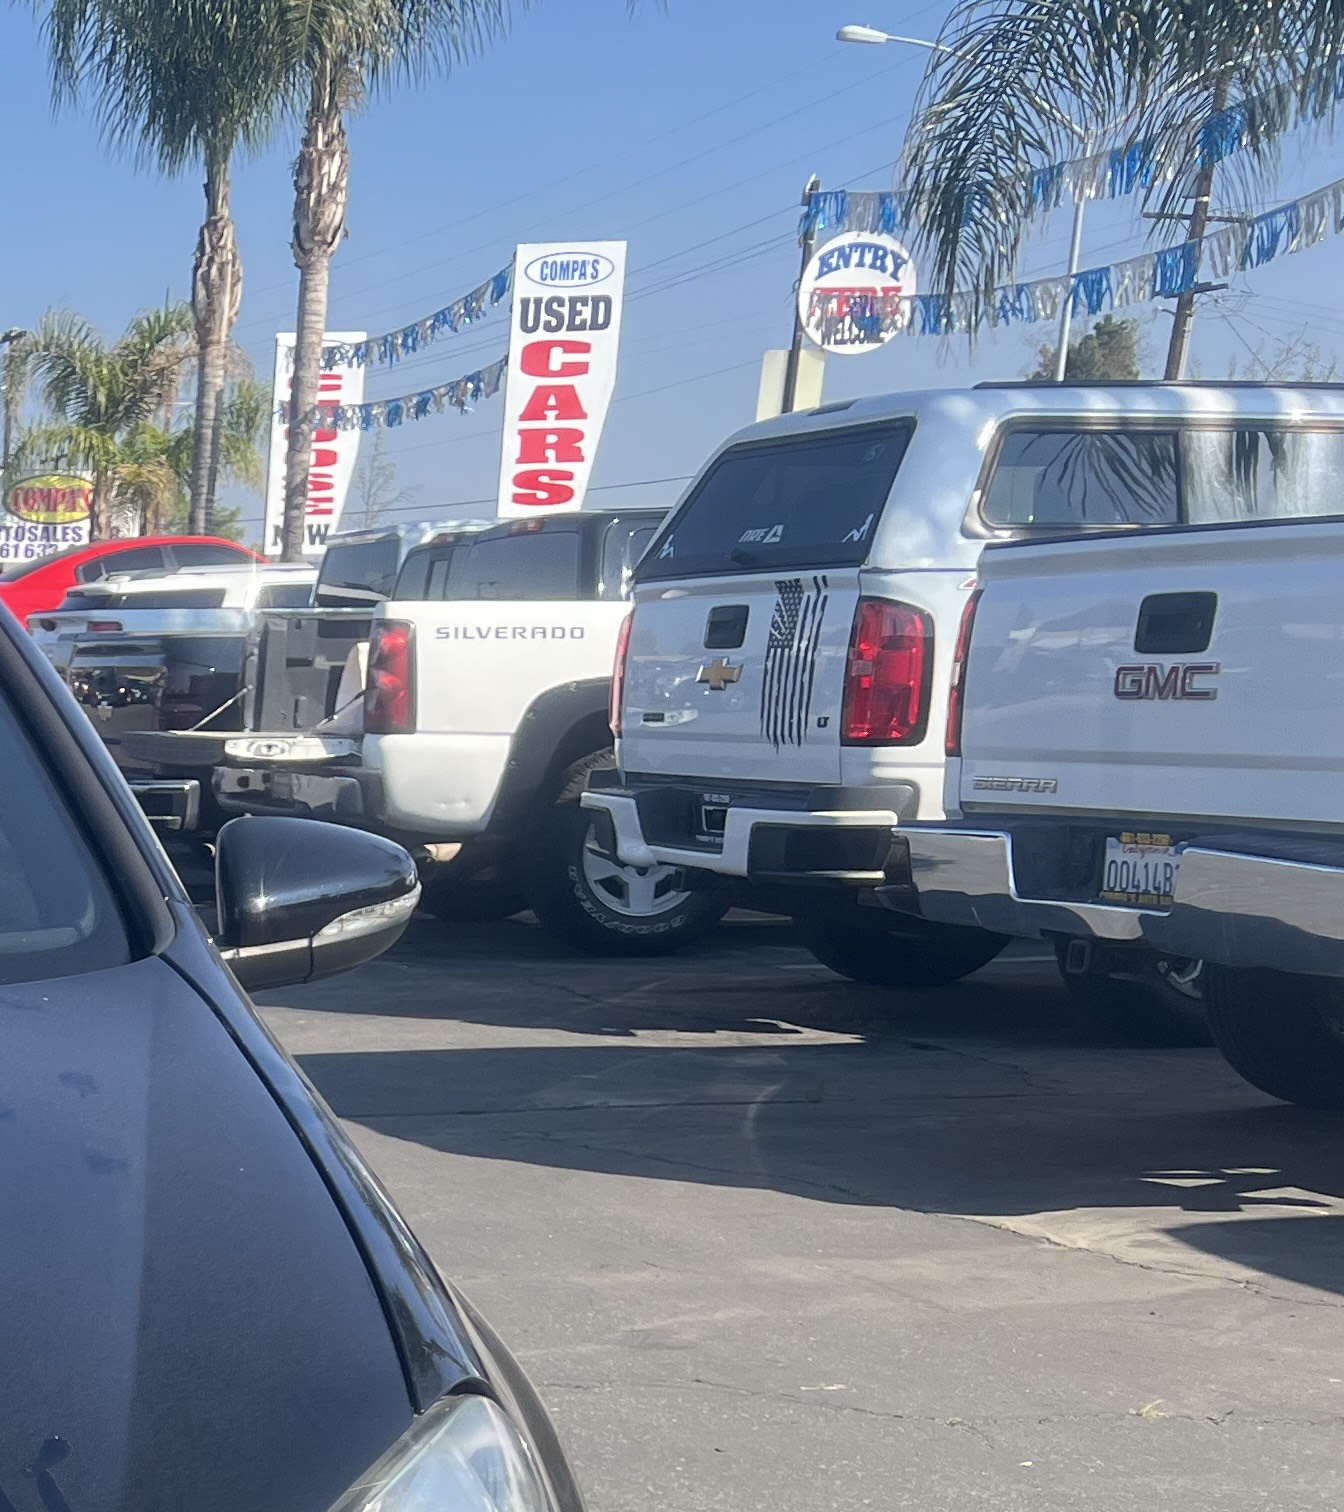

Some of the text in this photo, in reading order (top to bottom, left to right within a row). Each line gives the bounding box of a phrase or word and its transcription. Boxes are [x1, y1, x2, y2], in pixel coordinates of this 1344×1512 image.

[540, 258, 600, 281] COMPA'S
[815, 241, 907, 282] ENTRY
[519, 295, 613, 334] USED
[512, 339, 592, 507] CARS
[435, 626, 586, 640] SILVERADO
[1114, 662, 1221, 701] GMC
[973, 776, 1058, 794] SIERRA
[1107, 860, 1180, 897] 00414B
